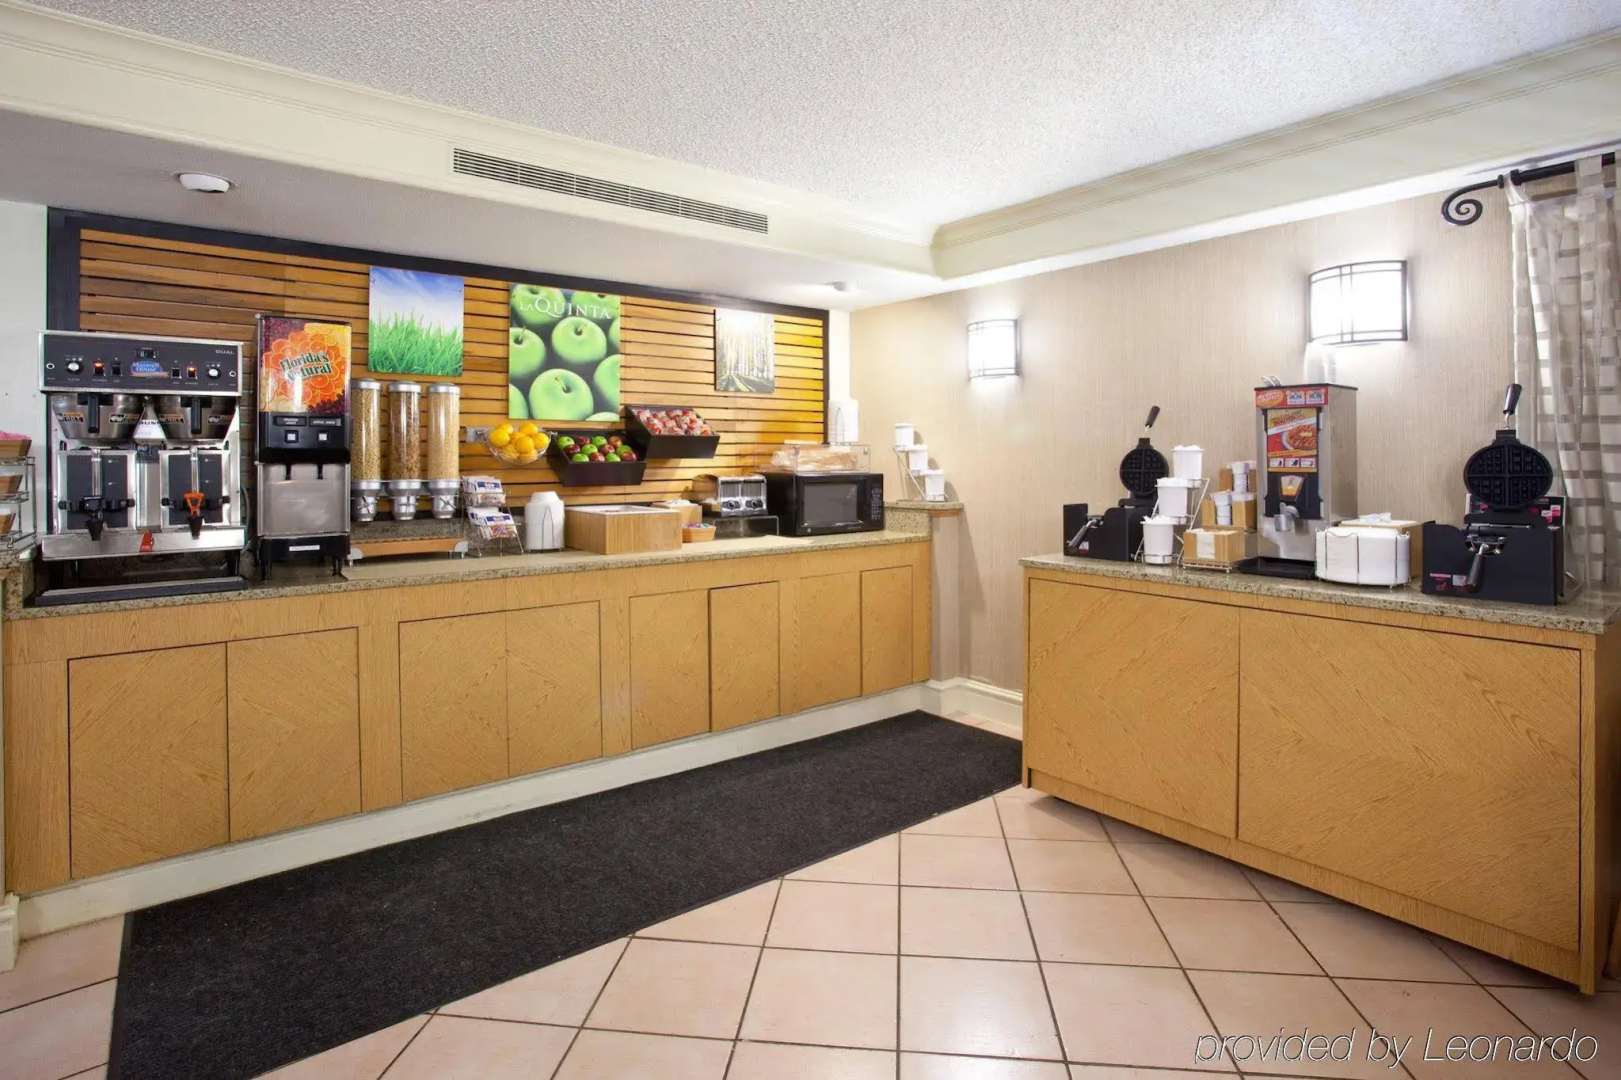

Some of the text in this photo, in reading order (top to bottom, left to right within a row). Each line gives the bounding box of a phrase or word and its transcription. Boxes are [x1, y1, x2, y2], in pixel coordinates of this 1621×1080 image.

[520, 298, 611, 319] LA QUINTA
[132, 361, 160, 369] Maxwell
[280, 350, 329, 372] Florida's
